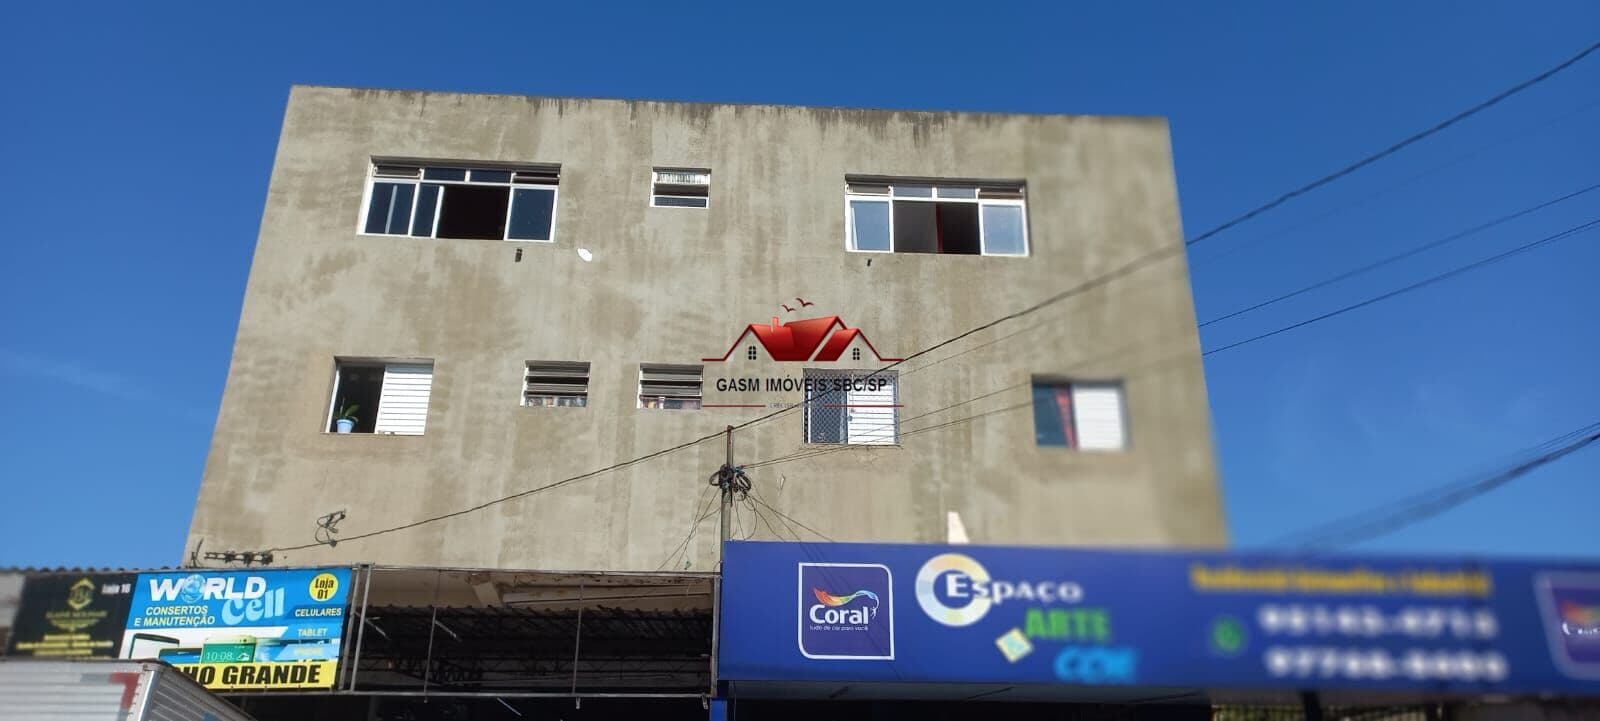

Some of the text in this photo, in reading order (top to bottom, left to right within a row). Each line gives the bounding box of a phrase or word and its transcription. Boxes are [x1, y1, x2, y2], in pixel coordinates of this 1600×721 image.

[149, 575, 267, 602] WORLD
[315, 578, 335, 589] Loja
[317, 589, 329, 599] 01
[145, 605, 208, 616] CONSERTOS
[221, 587, 285, 626] Cell
[295, 607, 342, 617] CELULARES
[809, 604, 869, 624] Coral
[134, 614, 216, 628] E MANUTENÇÃO
[298, 627, 328, 637] TABLET
[221, 664, 321, 685] GRANDE
